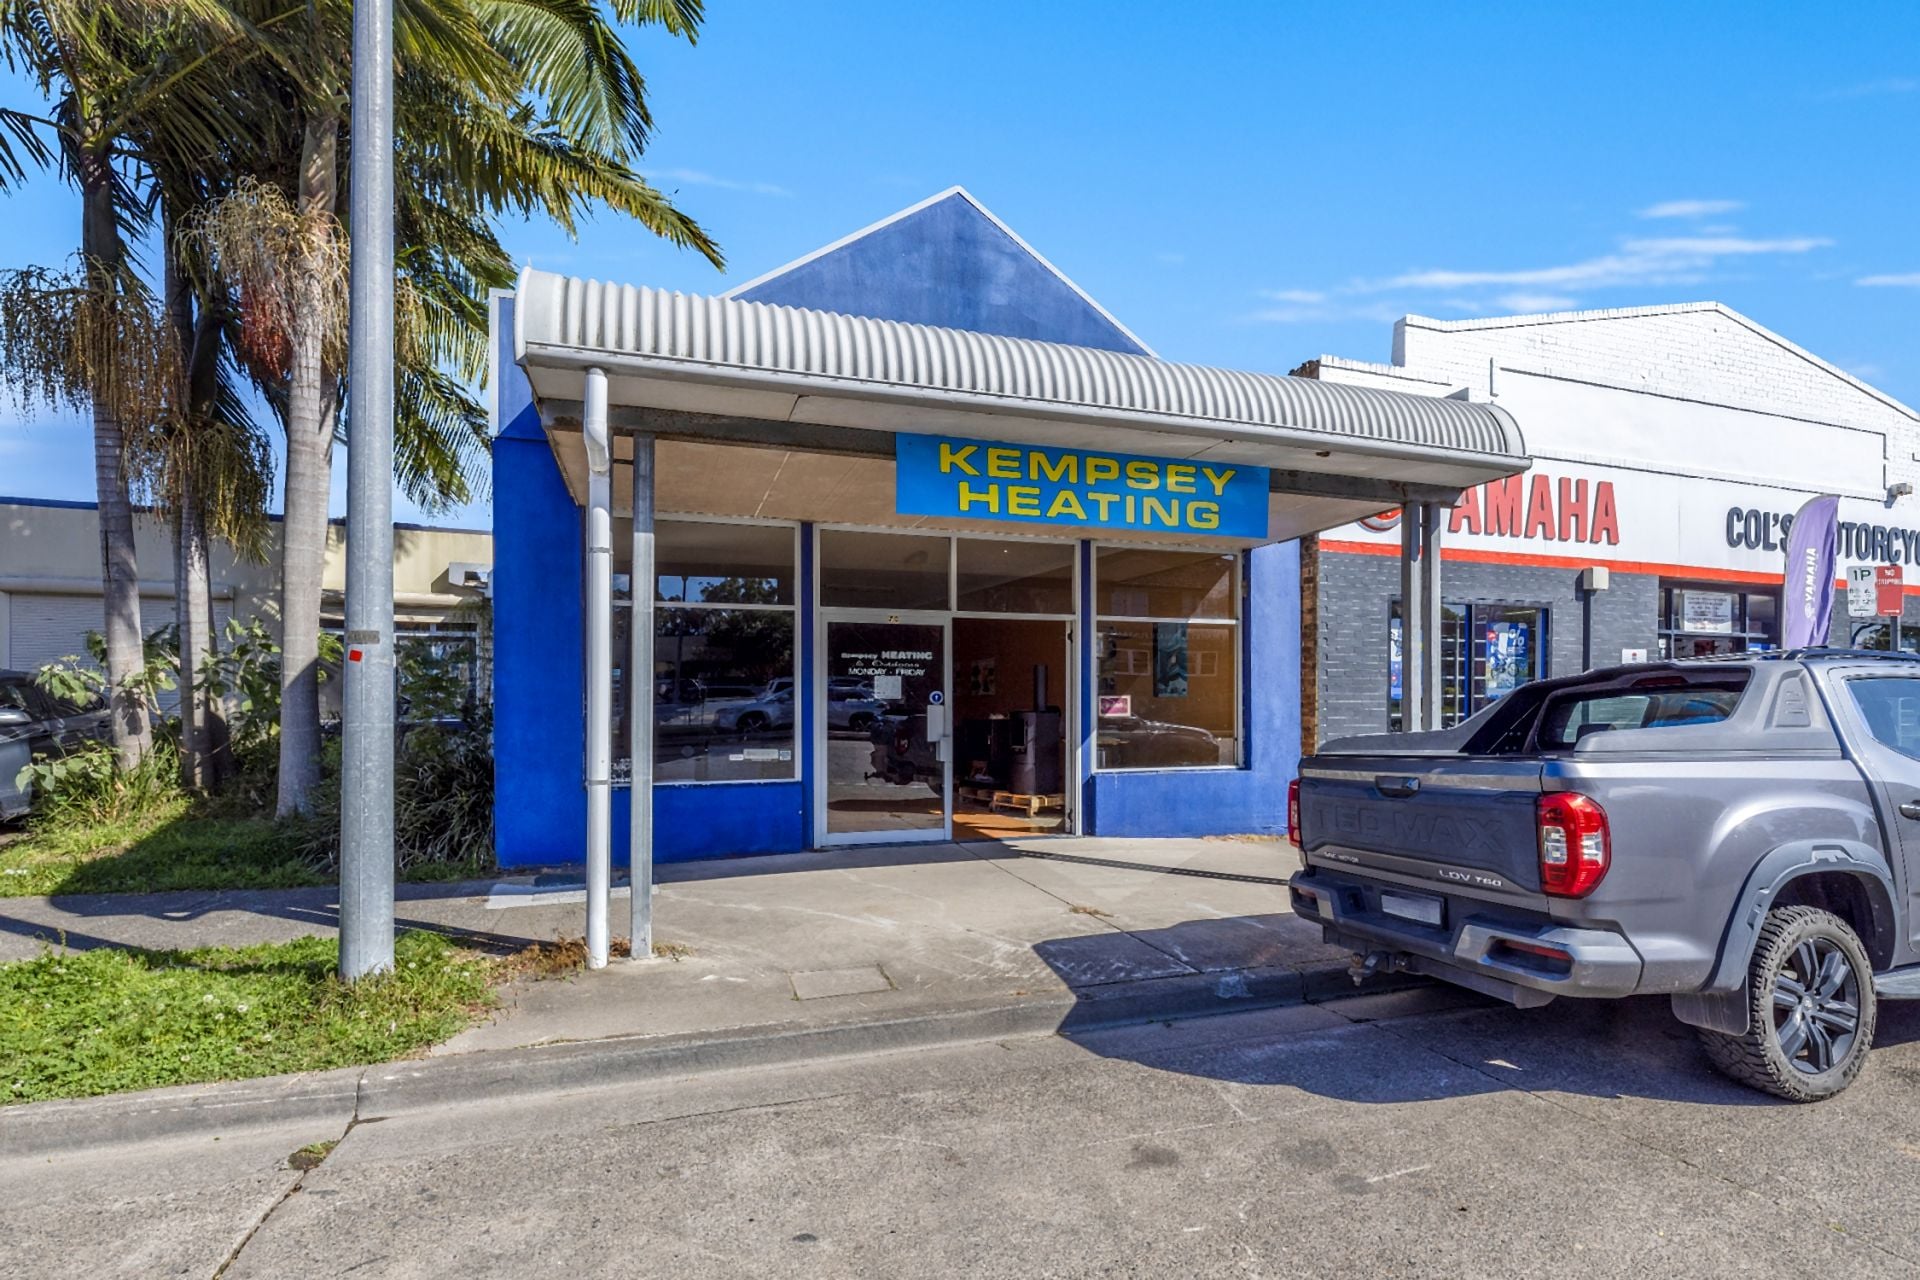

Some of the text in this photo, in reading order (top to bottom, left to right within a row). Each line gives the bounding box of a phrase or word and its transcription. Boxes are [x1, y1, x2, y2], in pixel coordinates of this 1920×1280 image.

[939, 443, 1236, 496] KEMPSEY
[958, 481, 1220, 530] HEATING
[1448, 472, 1620, 545] AMAHA
[1804, 547, 1819, 602] YAMAHA
[1853, 569, 1872, 581] 1P
[881, 651, 932, 660] HEATING
[1438, 869, 1471, 882] LDV
